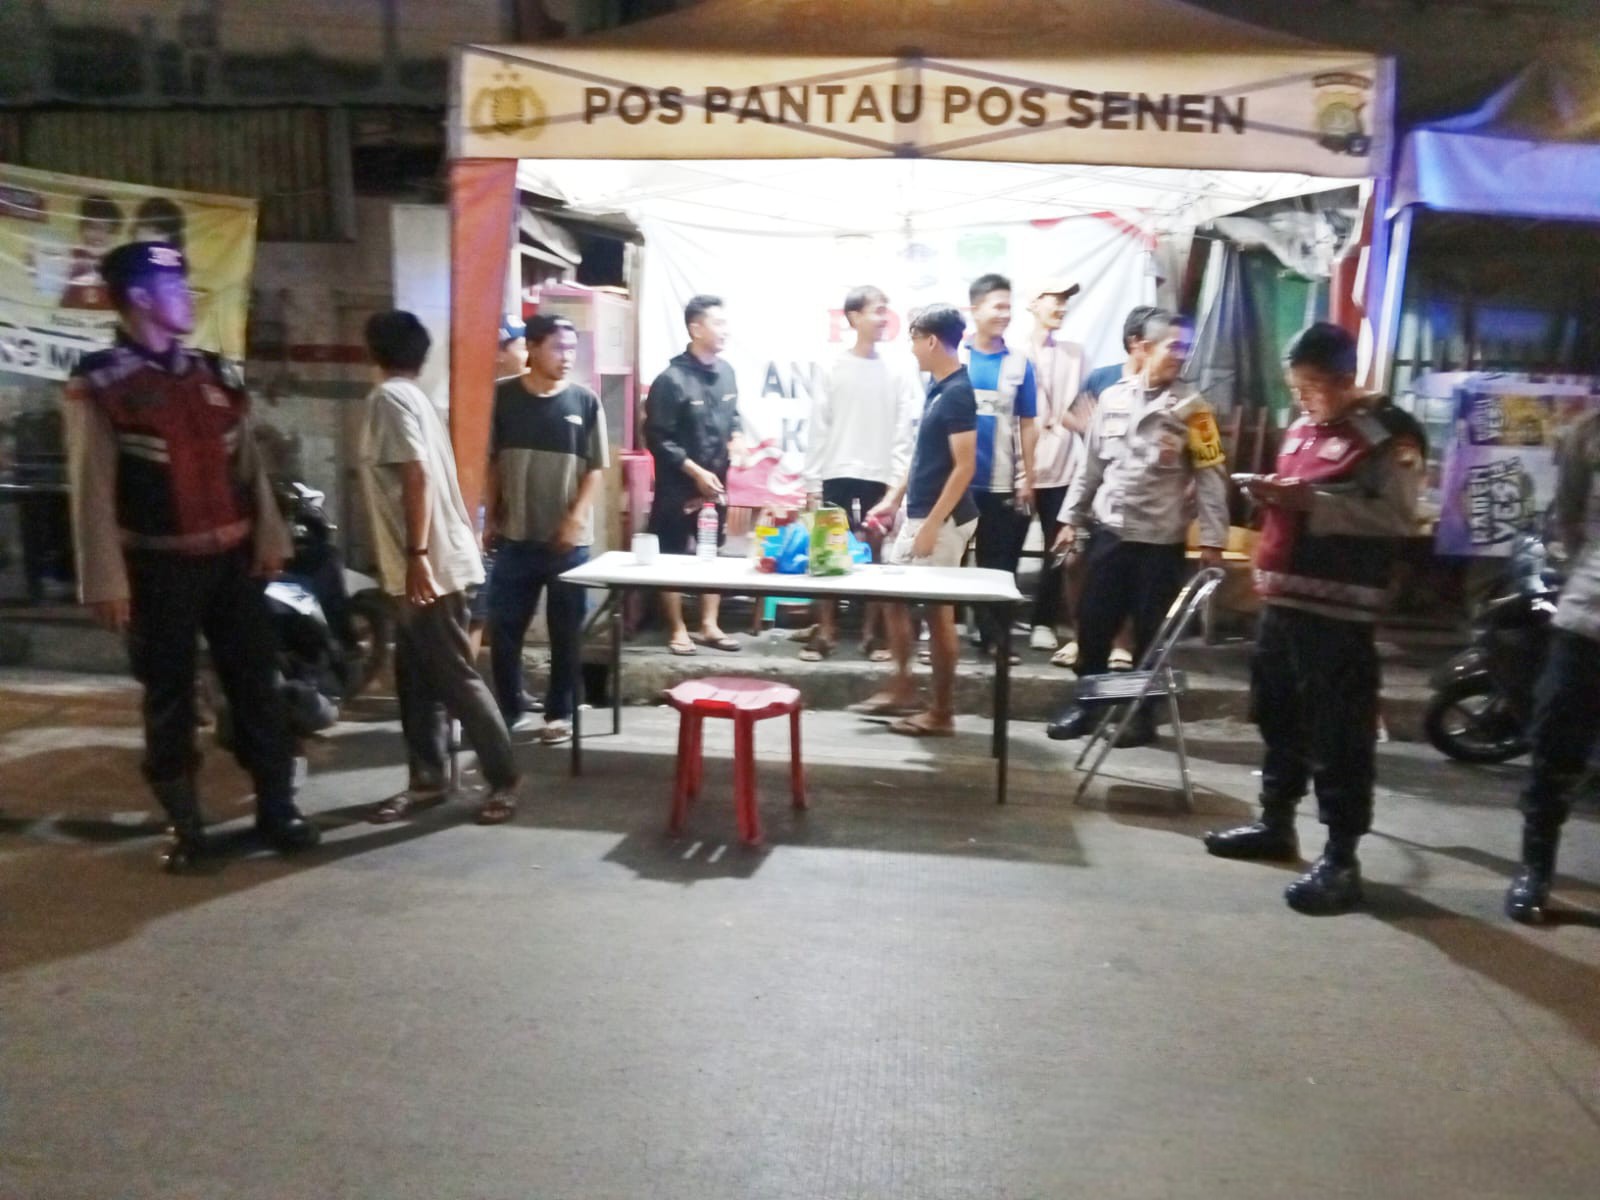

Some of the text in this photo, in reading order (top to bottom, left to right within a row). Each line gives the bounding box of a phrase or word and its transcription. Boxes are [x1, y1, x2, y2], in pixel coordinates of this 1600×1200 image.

[584, 84, 1248, 135] POS PANTAU POS SENEN
